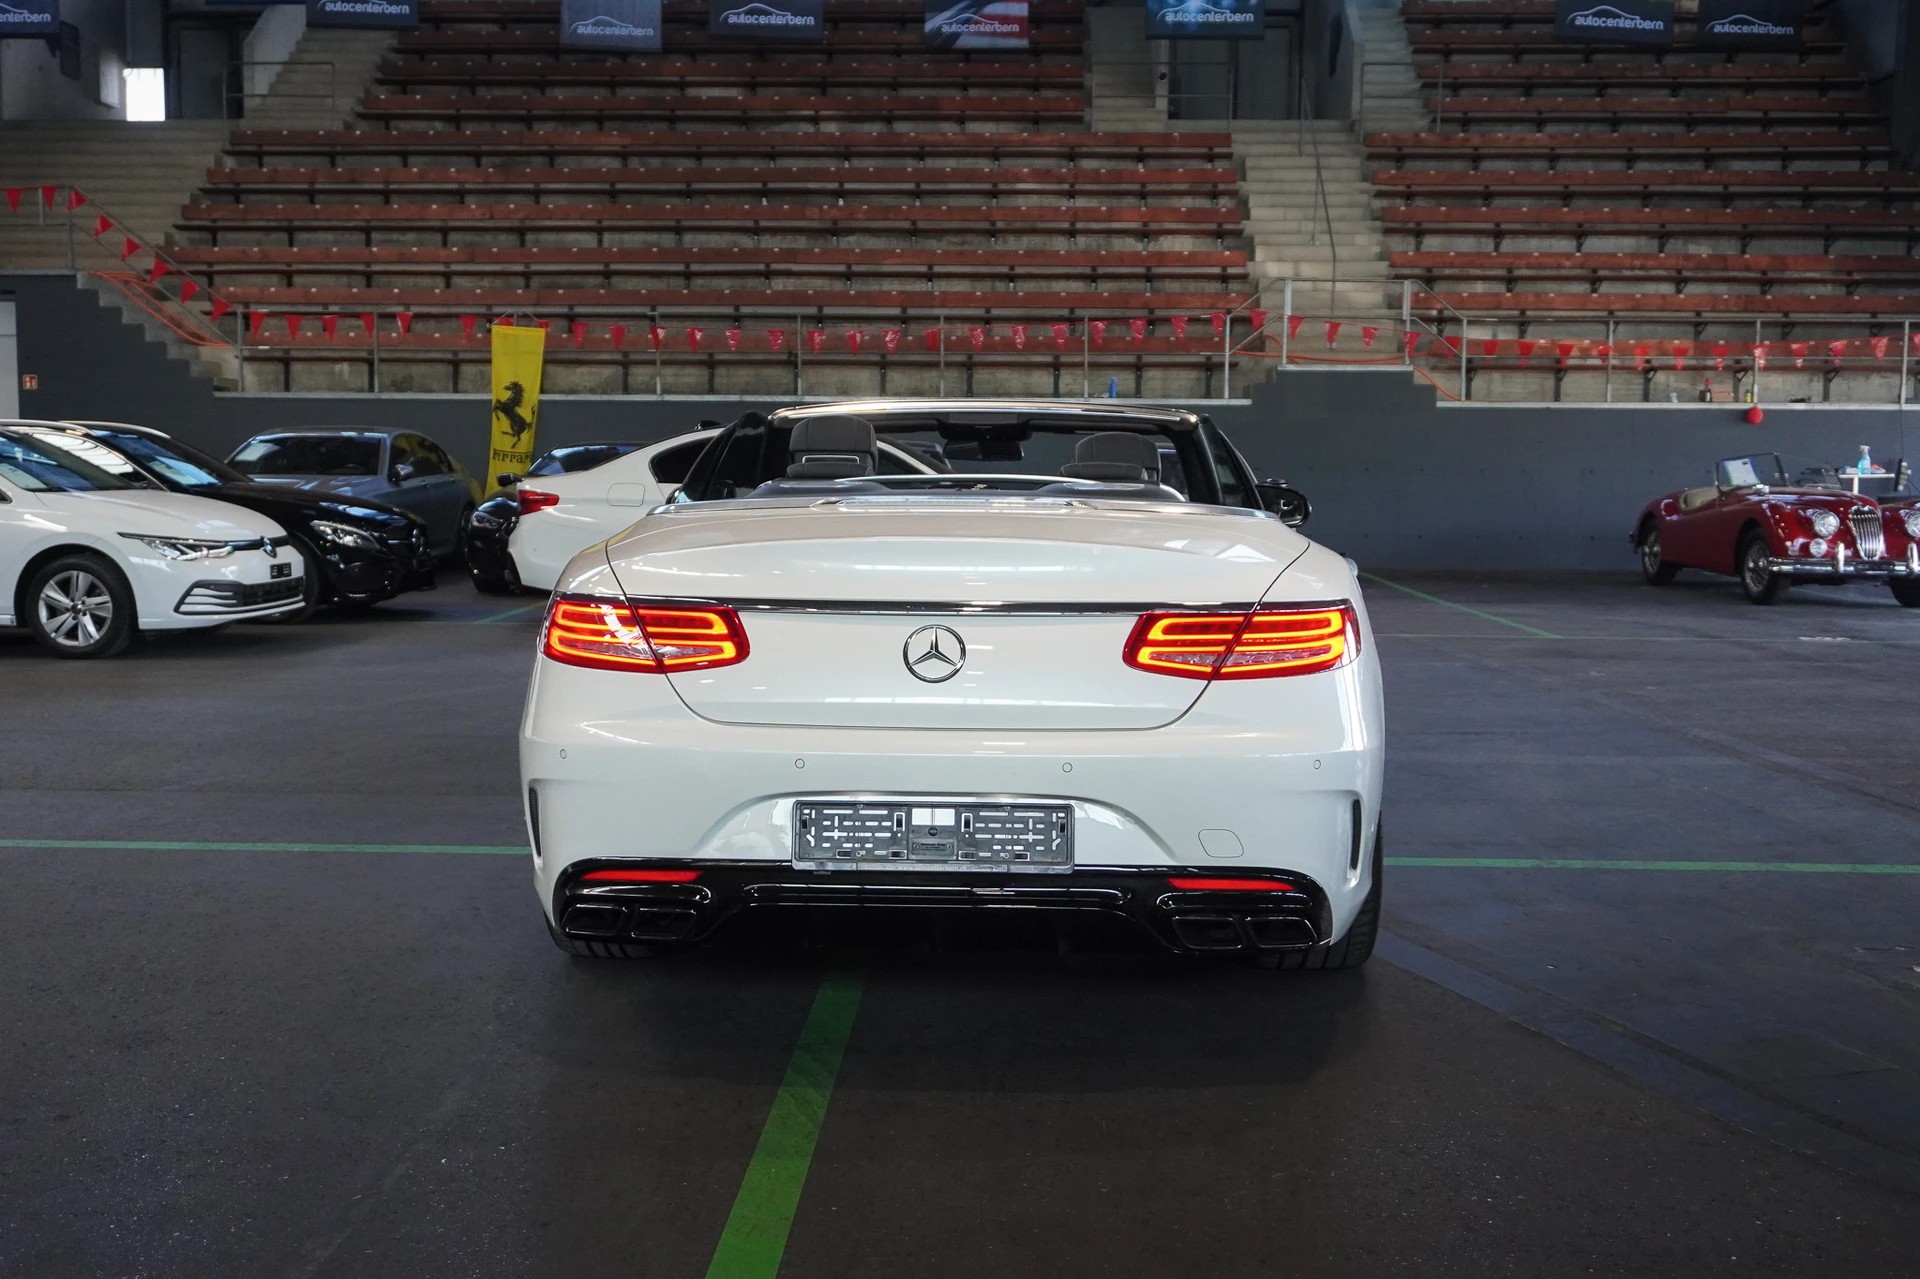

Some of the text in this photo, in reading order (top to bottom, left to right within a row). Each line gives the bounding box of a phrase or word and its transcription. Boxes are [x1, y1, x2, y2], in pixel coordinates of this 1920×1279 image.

[325, 1, 410, 14] autocenterbern
[728, 13, 815, 25] autocenterbern
[1165, 11, 1254, 22] autocenterbern
[1574, 15, 1664, 30] autocenterbern
[577, 24, 654, 36] autocenterbern
[941, 23, 1019, 32] autocenterbern
[1713, 23, 1794, 35] autocenterbern
